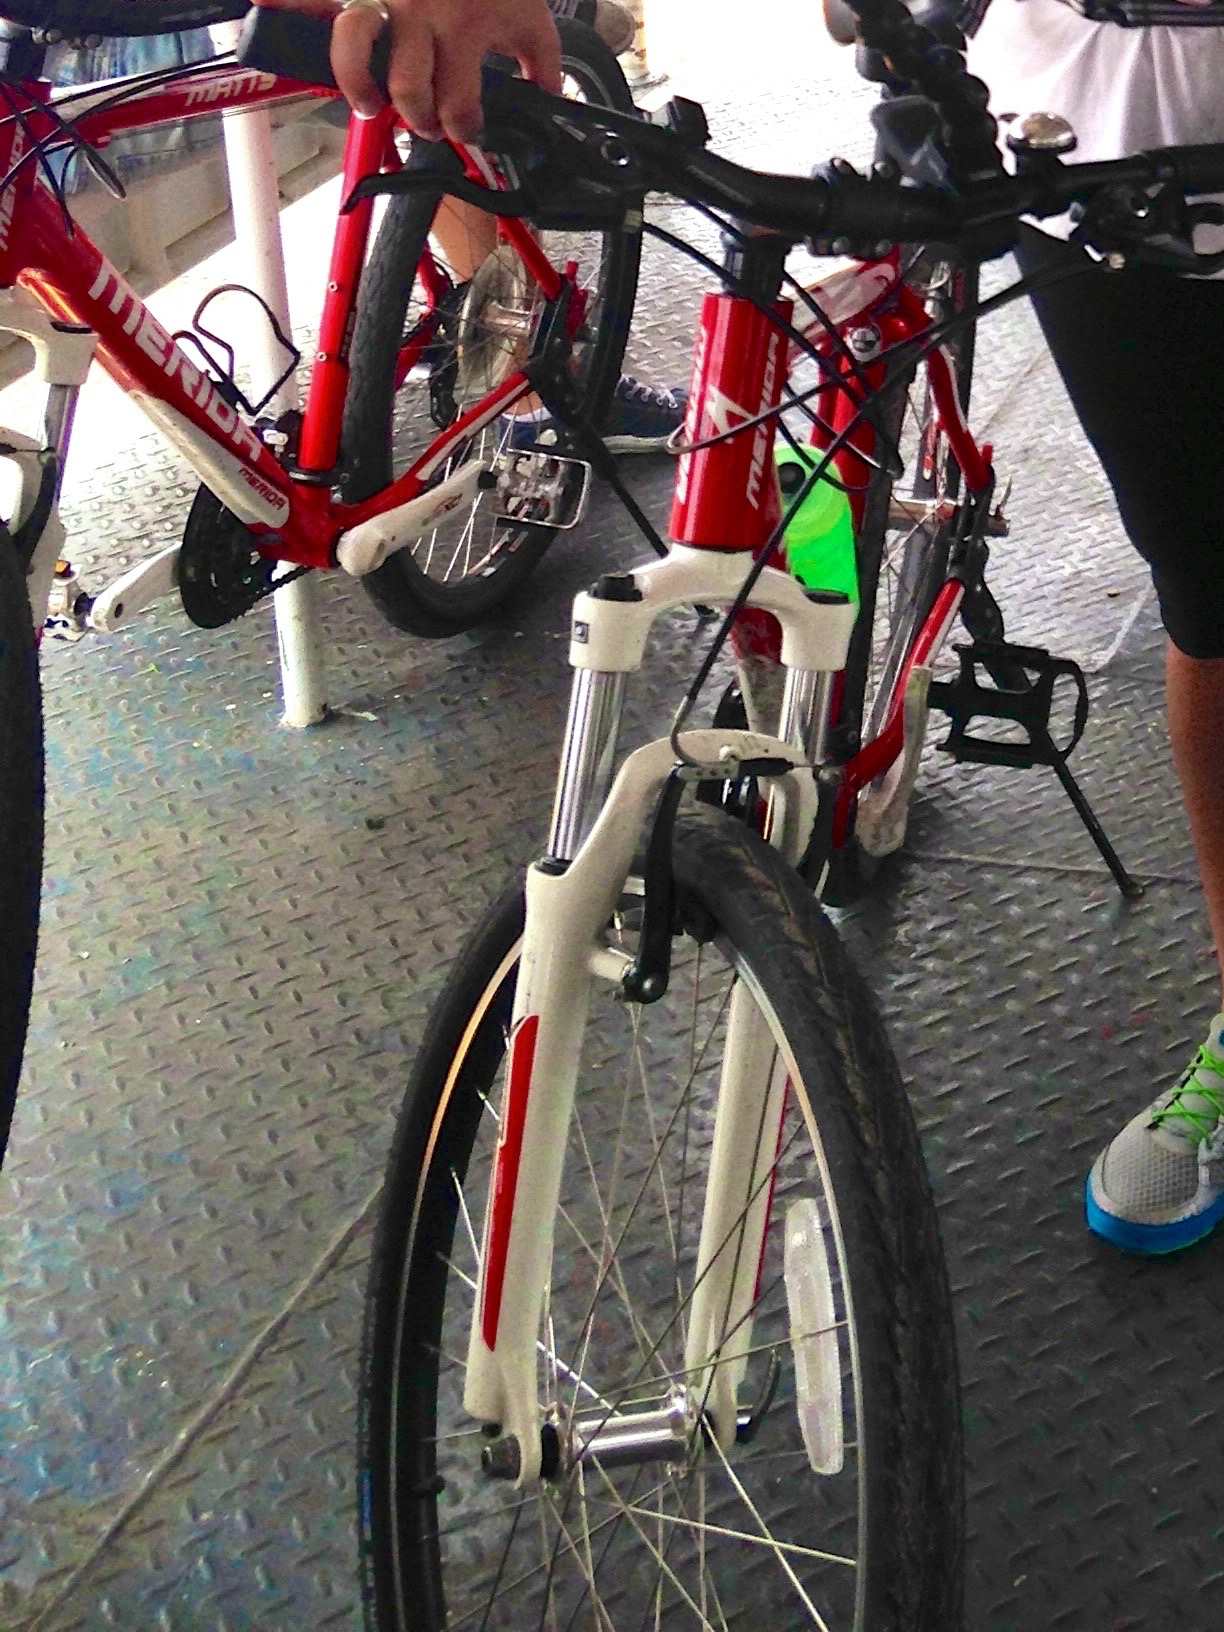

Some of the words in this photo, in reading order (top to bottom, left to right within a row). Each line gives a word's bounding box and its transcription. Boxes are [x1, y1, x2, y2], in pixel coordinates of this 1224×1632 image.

[88, 262, 263, 463] MERIDA
[746, 332, 779, 510] MERIDA
[238, 466, 288, 511] MERIDA
